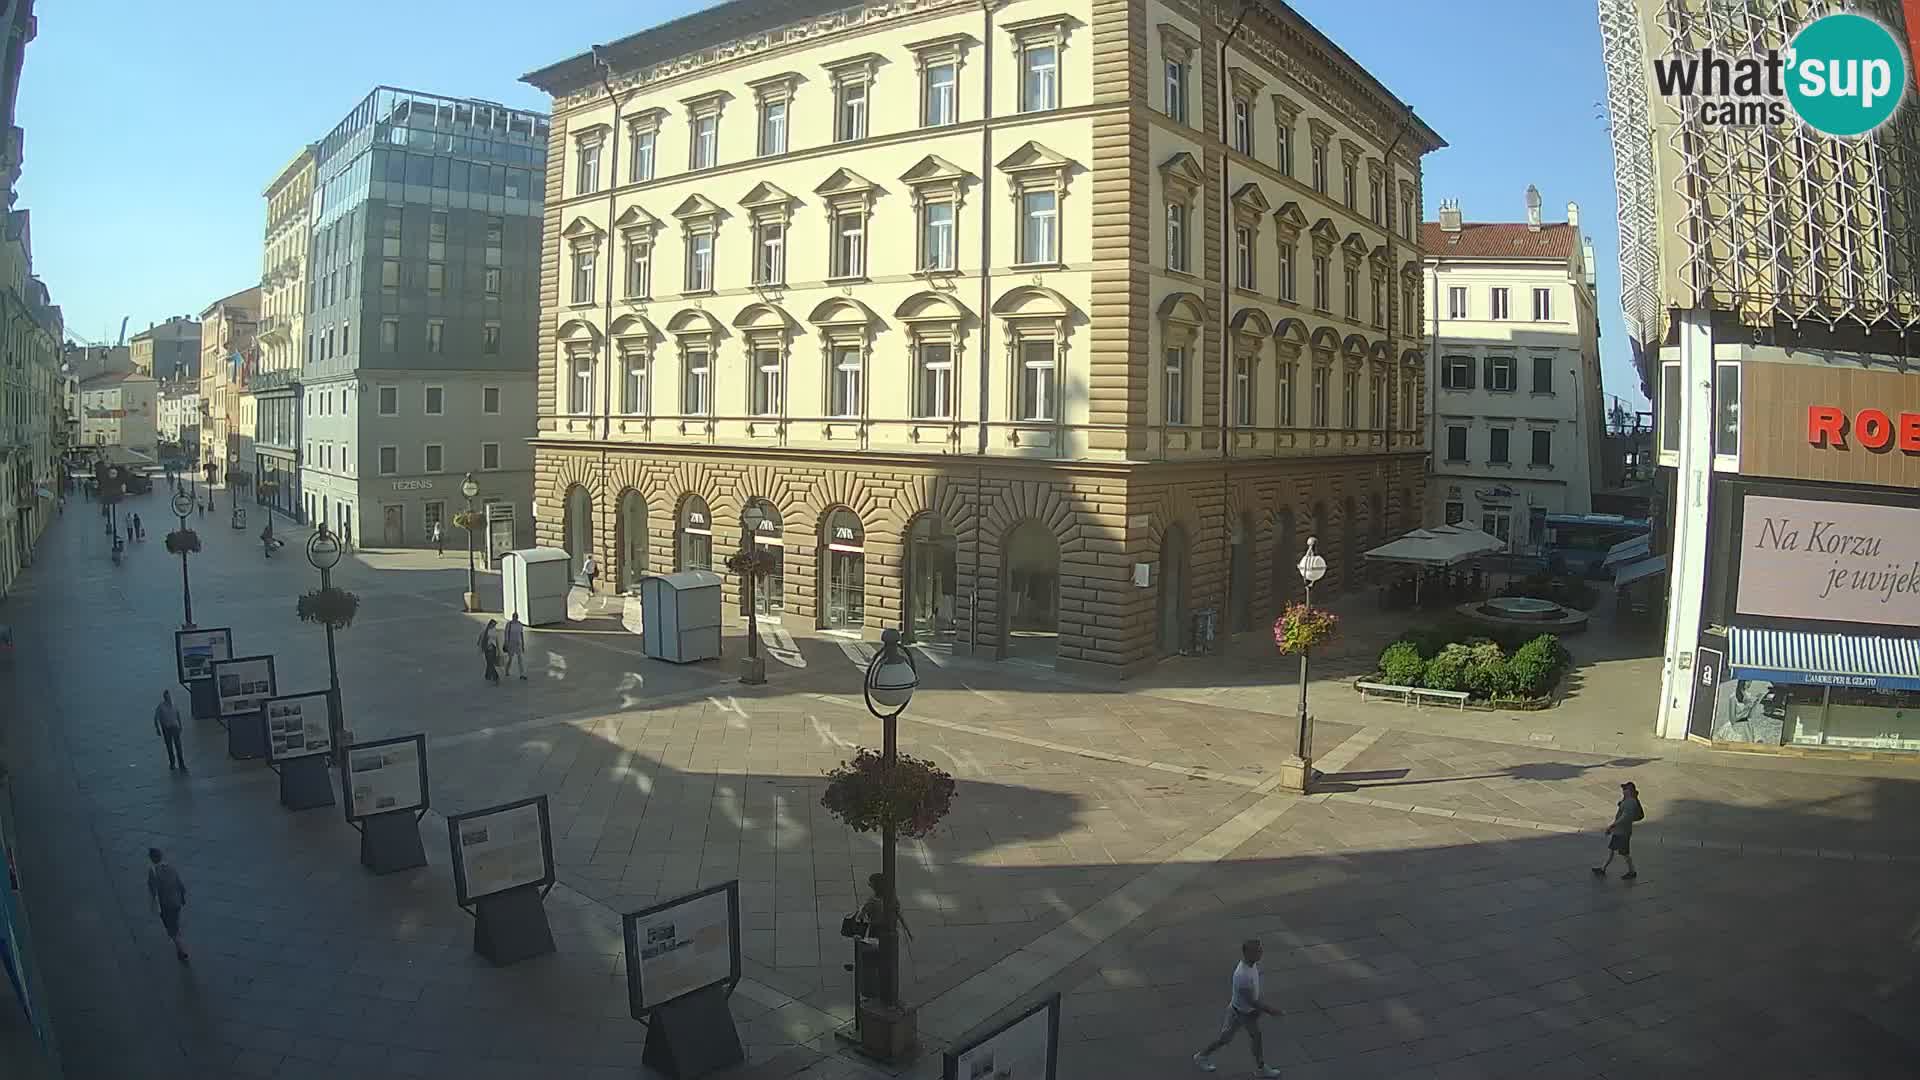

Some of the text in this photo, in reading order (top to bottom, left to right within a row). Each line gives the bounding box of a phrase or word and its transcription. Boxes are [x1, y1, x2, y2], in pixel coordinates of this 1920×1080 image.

[391, 479, 433, 491] TEZENIS
[1755, 517, 1882, 557] Na Korzu
[1819, 559, 1920, 604] je uvijek
[1852, 677, 1877, 687] GELATO
